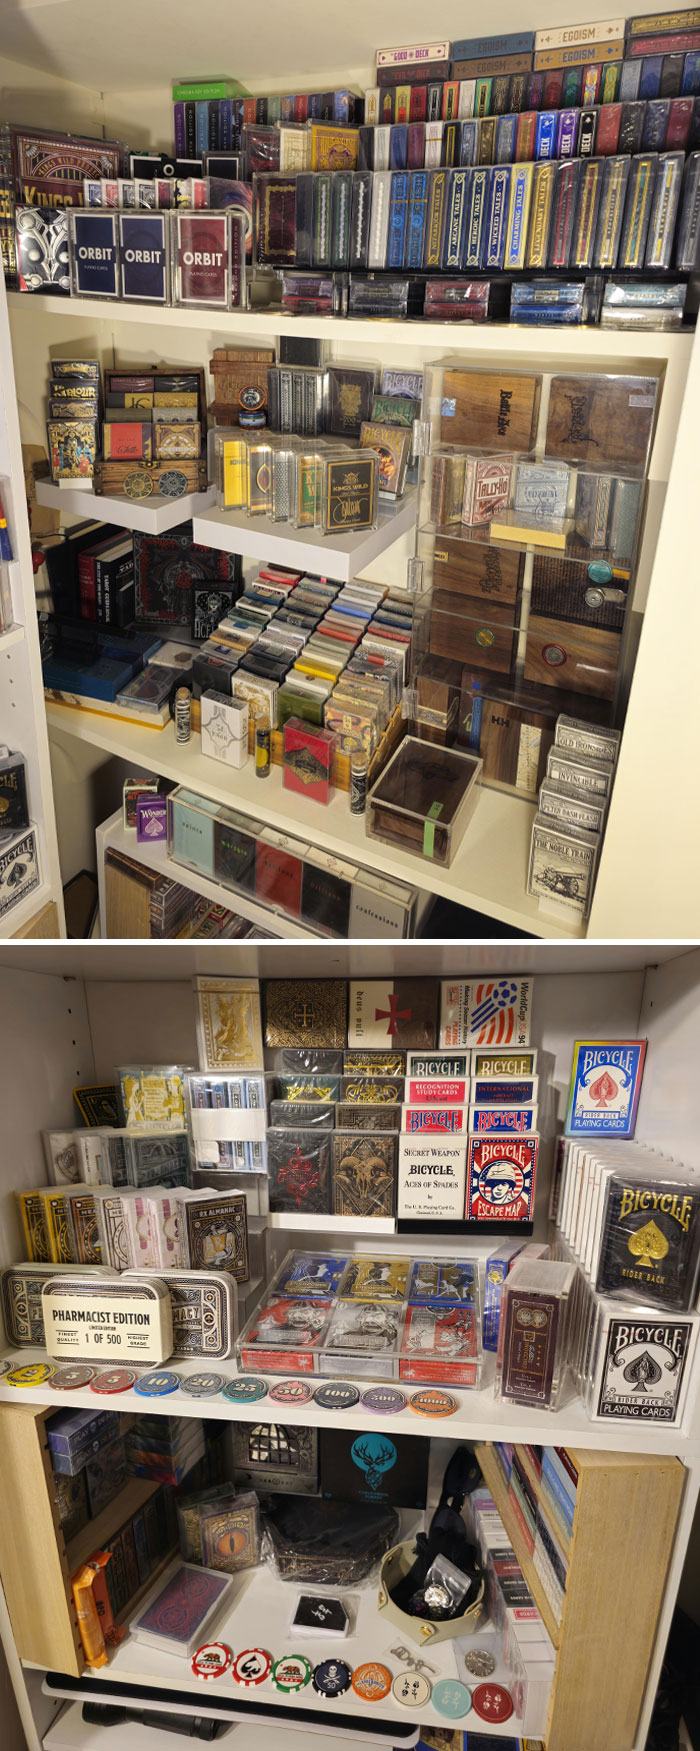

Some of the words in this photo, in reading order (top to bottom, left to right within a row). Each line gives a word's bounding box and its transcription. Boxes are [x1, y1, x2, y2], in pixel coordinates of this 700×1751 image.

[562, 28, 596, 42] EGOISM
[478, 40, 507, 52] EGOISM
[562, 47, 596, 62] EGOISM
[477, 60, 507, 73] EGOISM
[540, 135, 550, 157] DECK
[561, 133, 571, 155] DECK
[581, 133, 592, 154] DECK
[516, 184, 525, 210] TALES
[538, 180, 547, 205] TALES
[473, 193, 481, 218] TALES
[494, 191, 502, 216] TALES
[452, 218, 460, 246] ARCANE
[471, 219, 479, 245] HEROIC
[492, 216, 500, 246] WICKED
[512, 210, 522, 251] CHARMING
[534, 205, 545, 252] LEGENDARY
[79, 247, 113, 261] ORBIT
[125, 250, 161, 264] ORBIT
[183, 251, 223, 267] ORBIT
[362, 426, 404, 453] BICYCLE
[560, 738, 574, 747] OLD
[559, 772, 599, 787] INVINCIBLE
[562, 807, 577, 820] DASH
[535, 839, 549, 851] THE
[549, 842, 570, 856] NOBLE
[571, 847, 591, 861] TRAIN
[416, 1061, 460, 1076] BICYCLE
[481, 1060, 527, 1076] BICYCLE
[583, 1050, 634, 1077] BICYCLE
[410, 1111, 459, 1132] BICYCLE
[477, 1111, 529, 1132] BICYCLE
[574, 1120, 602, 1128] PLAYING
[602, 1120, 625, 1128] CARDS
[480, 1144, 526, 1168] BICYCLE
[408, 1164, 456, 1177] BICYCLE
[208, 1206, 236, 1217] ALMANAC
[478, 1201, 505, 1217] ESCAPE
[504, 1201, 522, 1217] MAP
[618, 1188, 694, 1232] BICYCLE
[622, 1268, 644, 1280] RIDER
[646, 1273, 666, 1285] BACK
[52, 1309, 112, 1324] PHARMACIST
[112, 1312, 150, 1326] EDITION
[85, 1333, 89, 1343] 1
[94, 1333, 104, 1344] OF
[107, 1334, 122, 1345] 500
[614, 1326, 683, 1358] BICYCLE
[146, 1378, 169, 1387] 10
[190, 1378, 215, 1387] 20
[233, 1383, 257, 1393] 25
[278, 1386, 305, 1397] 50
[323, 1388, 351, 1399] 100
[370, 1394, 397, 1404] 500
[418, 1396, 448, 1406] 1000
[616, 1396, 639, 1405] RIDER
[641, 1398, 661, 1406] BACK
[603, 1404, 639, 1416] PLAYING
[640, 1406, 671, 1417] CARDS
